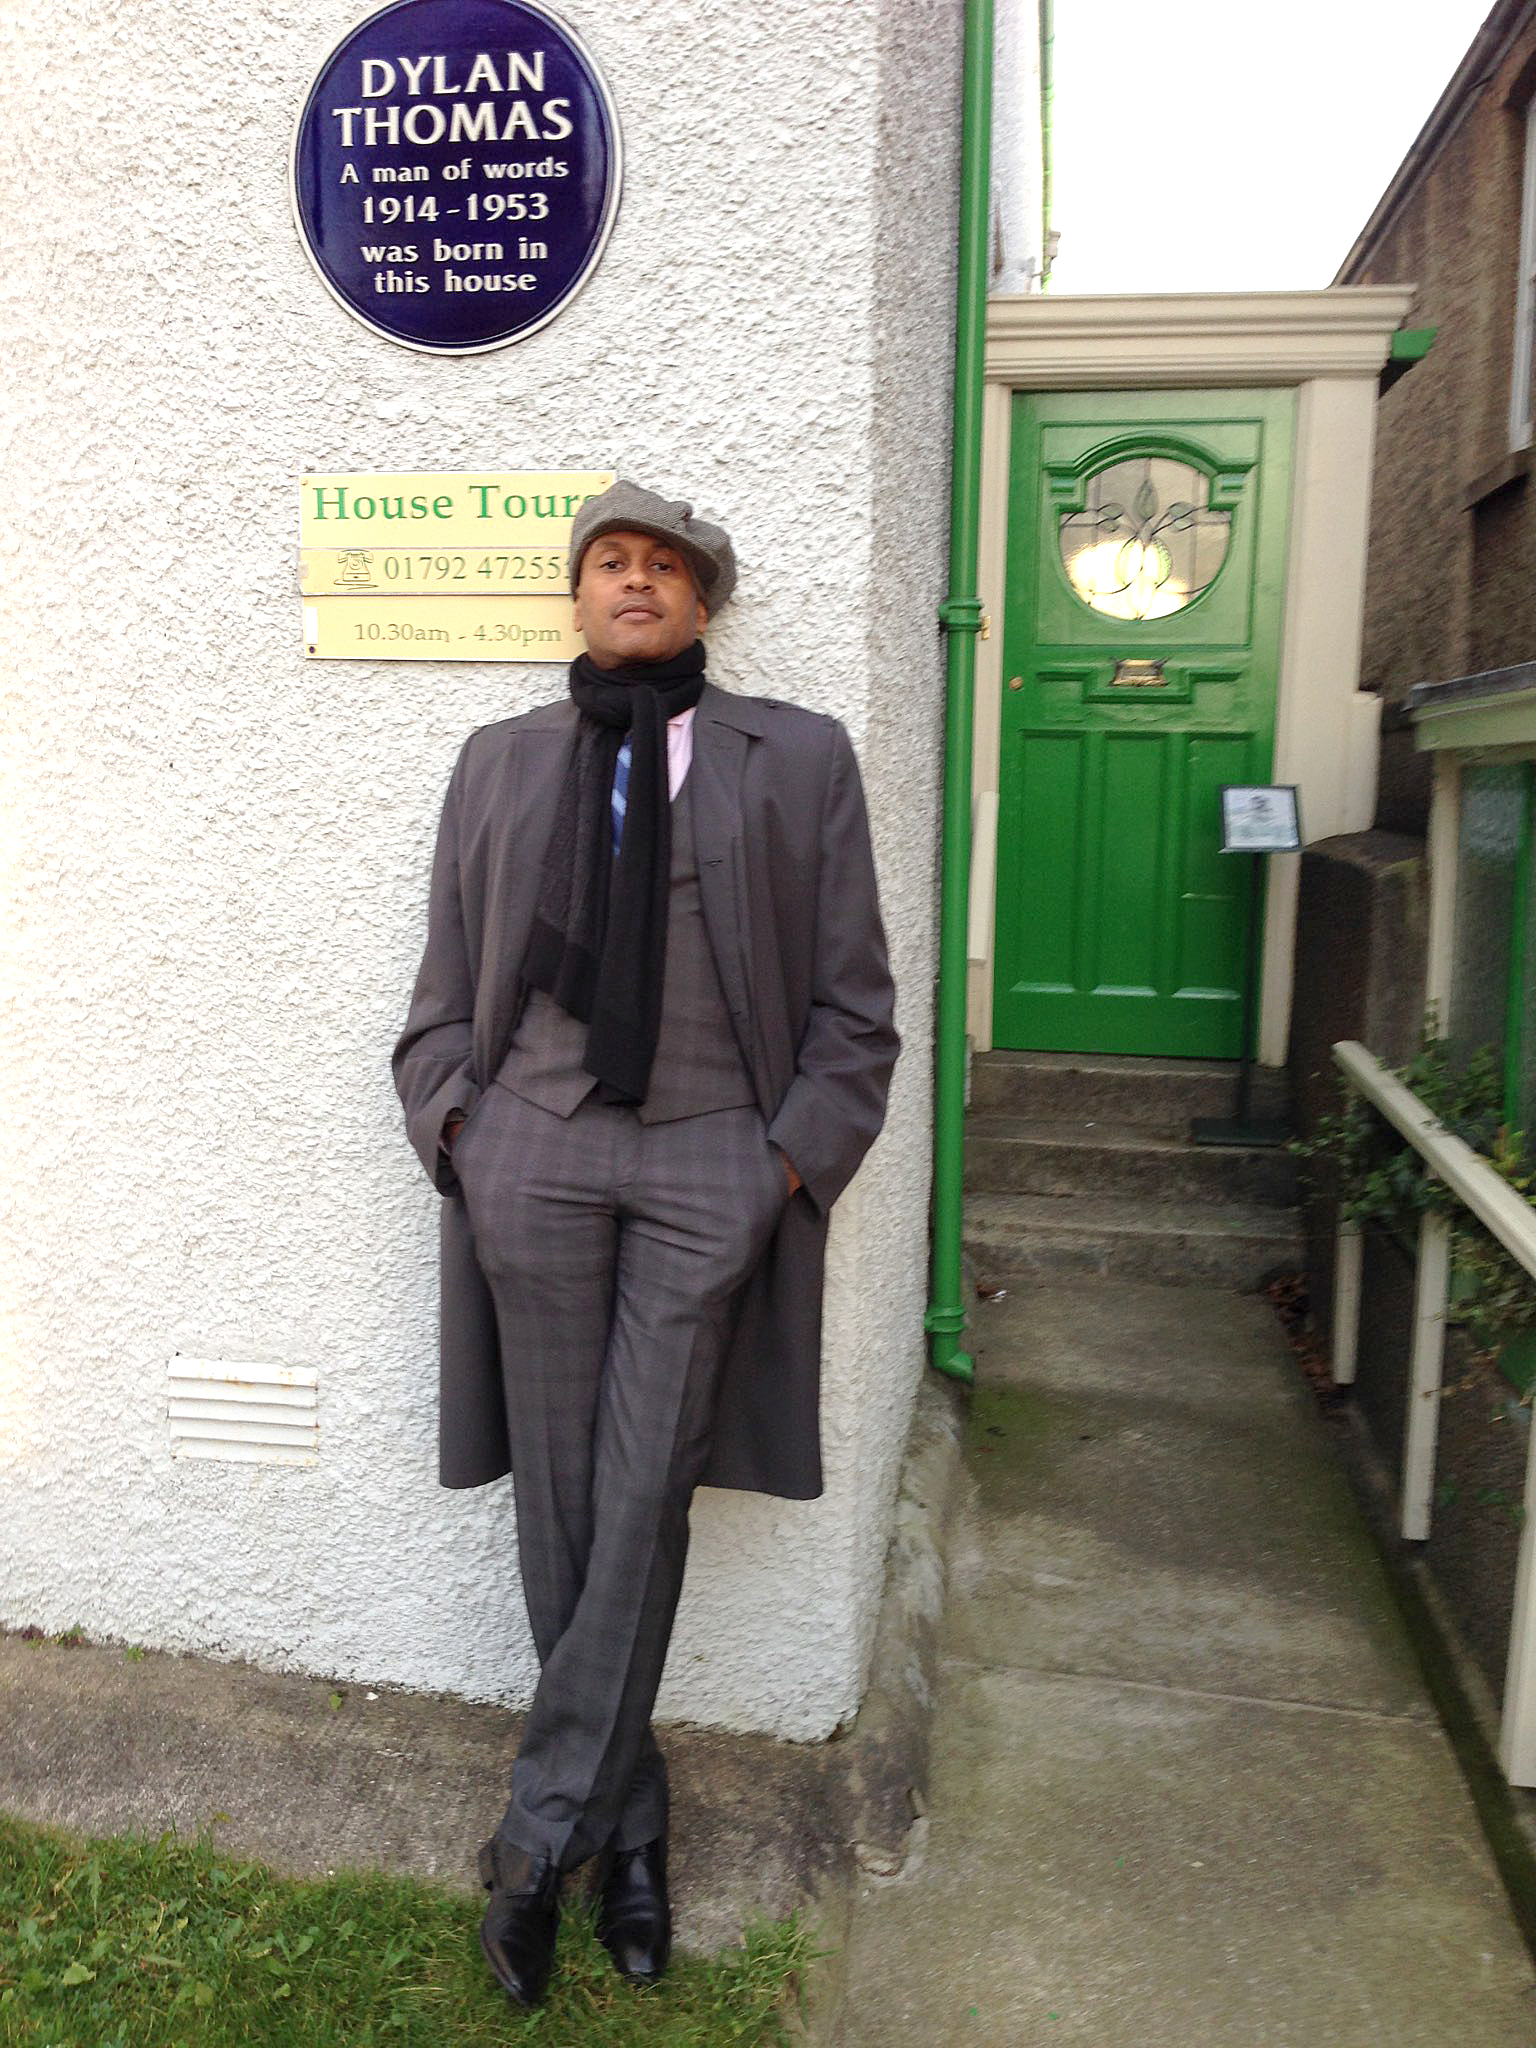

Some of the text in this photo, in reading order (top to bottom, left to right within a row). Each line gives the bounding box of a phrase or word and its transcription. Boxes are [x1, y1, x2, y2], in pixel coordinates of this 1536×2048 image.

[361, 52, 545, 98] DYLAN
[332, 99, 574, 147] THOMAS
[340, 156, 570, 184] A man of words
[361, 237, 548, 263] was born in
[374, 270, 537, 293] this house
[312, 485, 597, 520] House Tour
[384, 556, 570, 580] 01792 47255
[354, 623, 450, 642] 10.30am
[473, 624, 563, 647] 4.30pm
